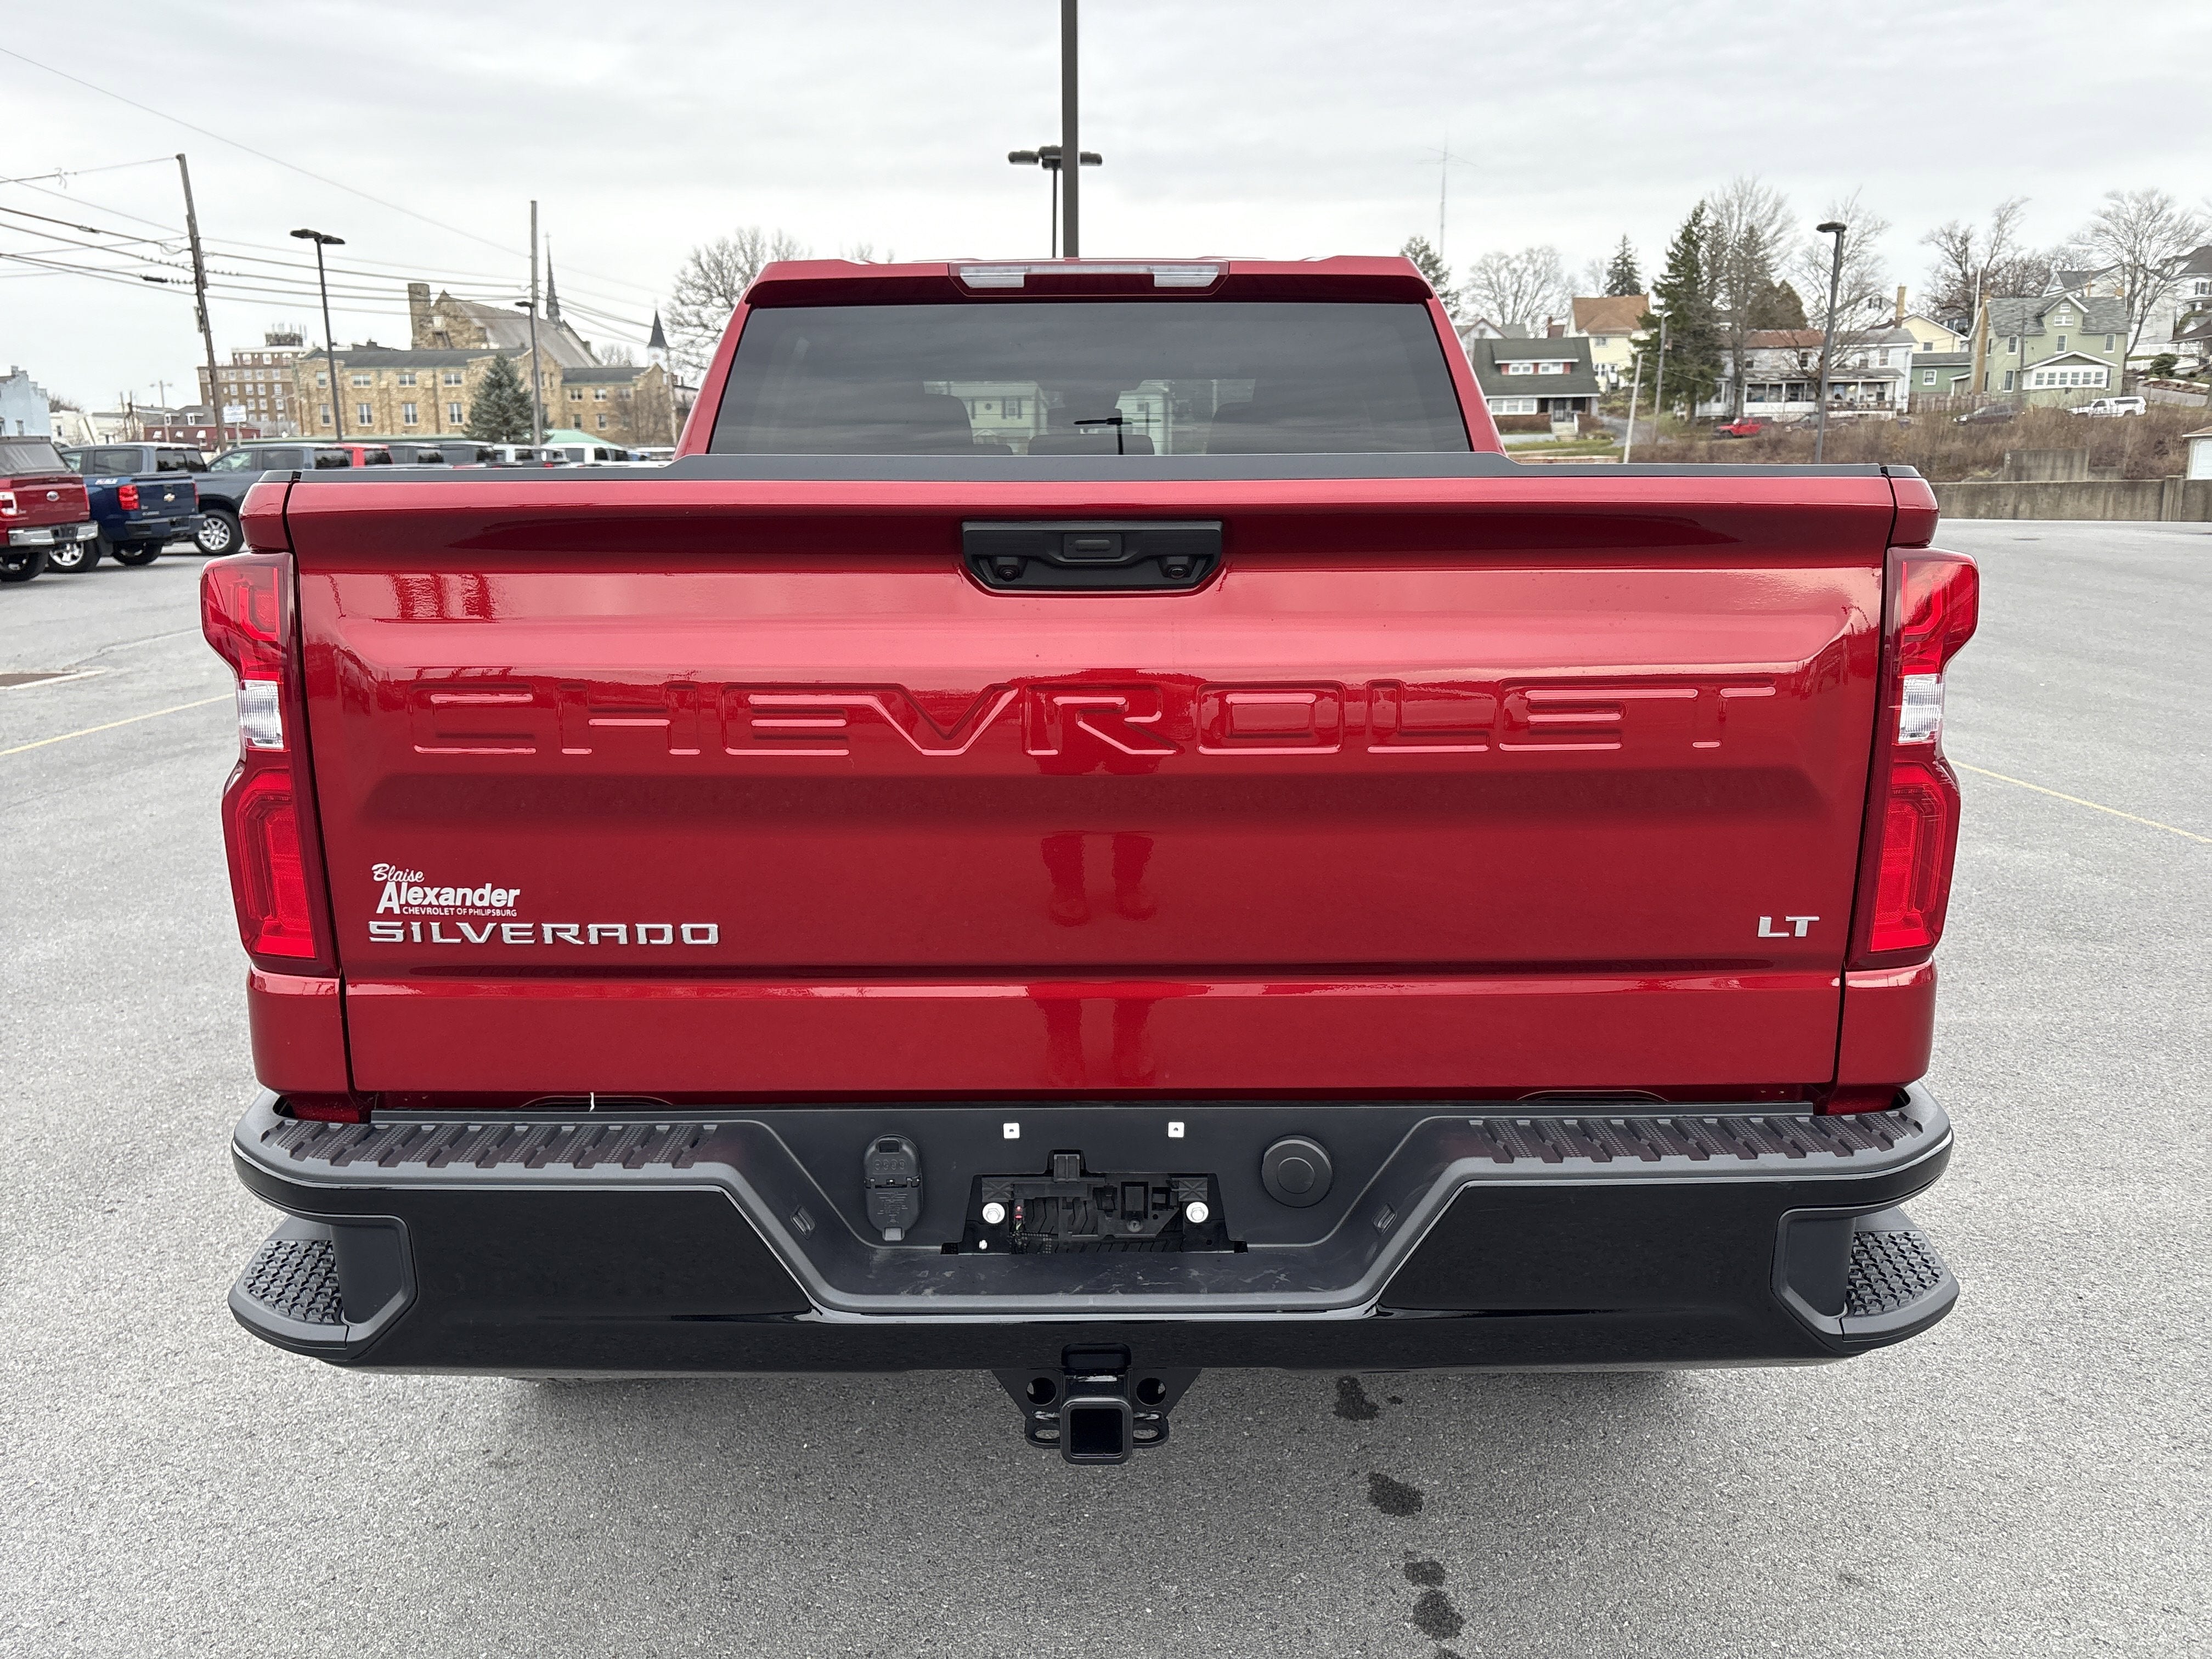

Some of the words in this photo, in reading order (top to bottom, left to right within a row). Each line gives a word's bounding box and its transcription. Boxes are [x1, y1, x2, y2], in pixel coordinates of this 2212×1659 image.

[409, 681, 1776, 757] CHEVROLET
[371, 863, 425, 883] Blaise
[376, 881, 521, 914] Alexander
[402, 906, 455, 916] CHEVROLET
[469, 909, 517, 917] PHILIPSBURG
[368, 921, 719, 945] SILVERADO
[1757, 916, 1820, 937] LT
